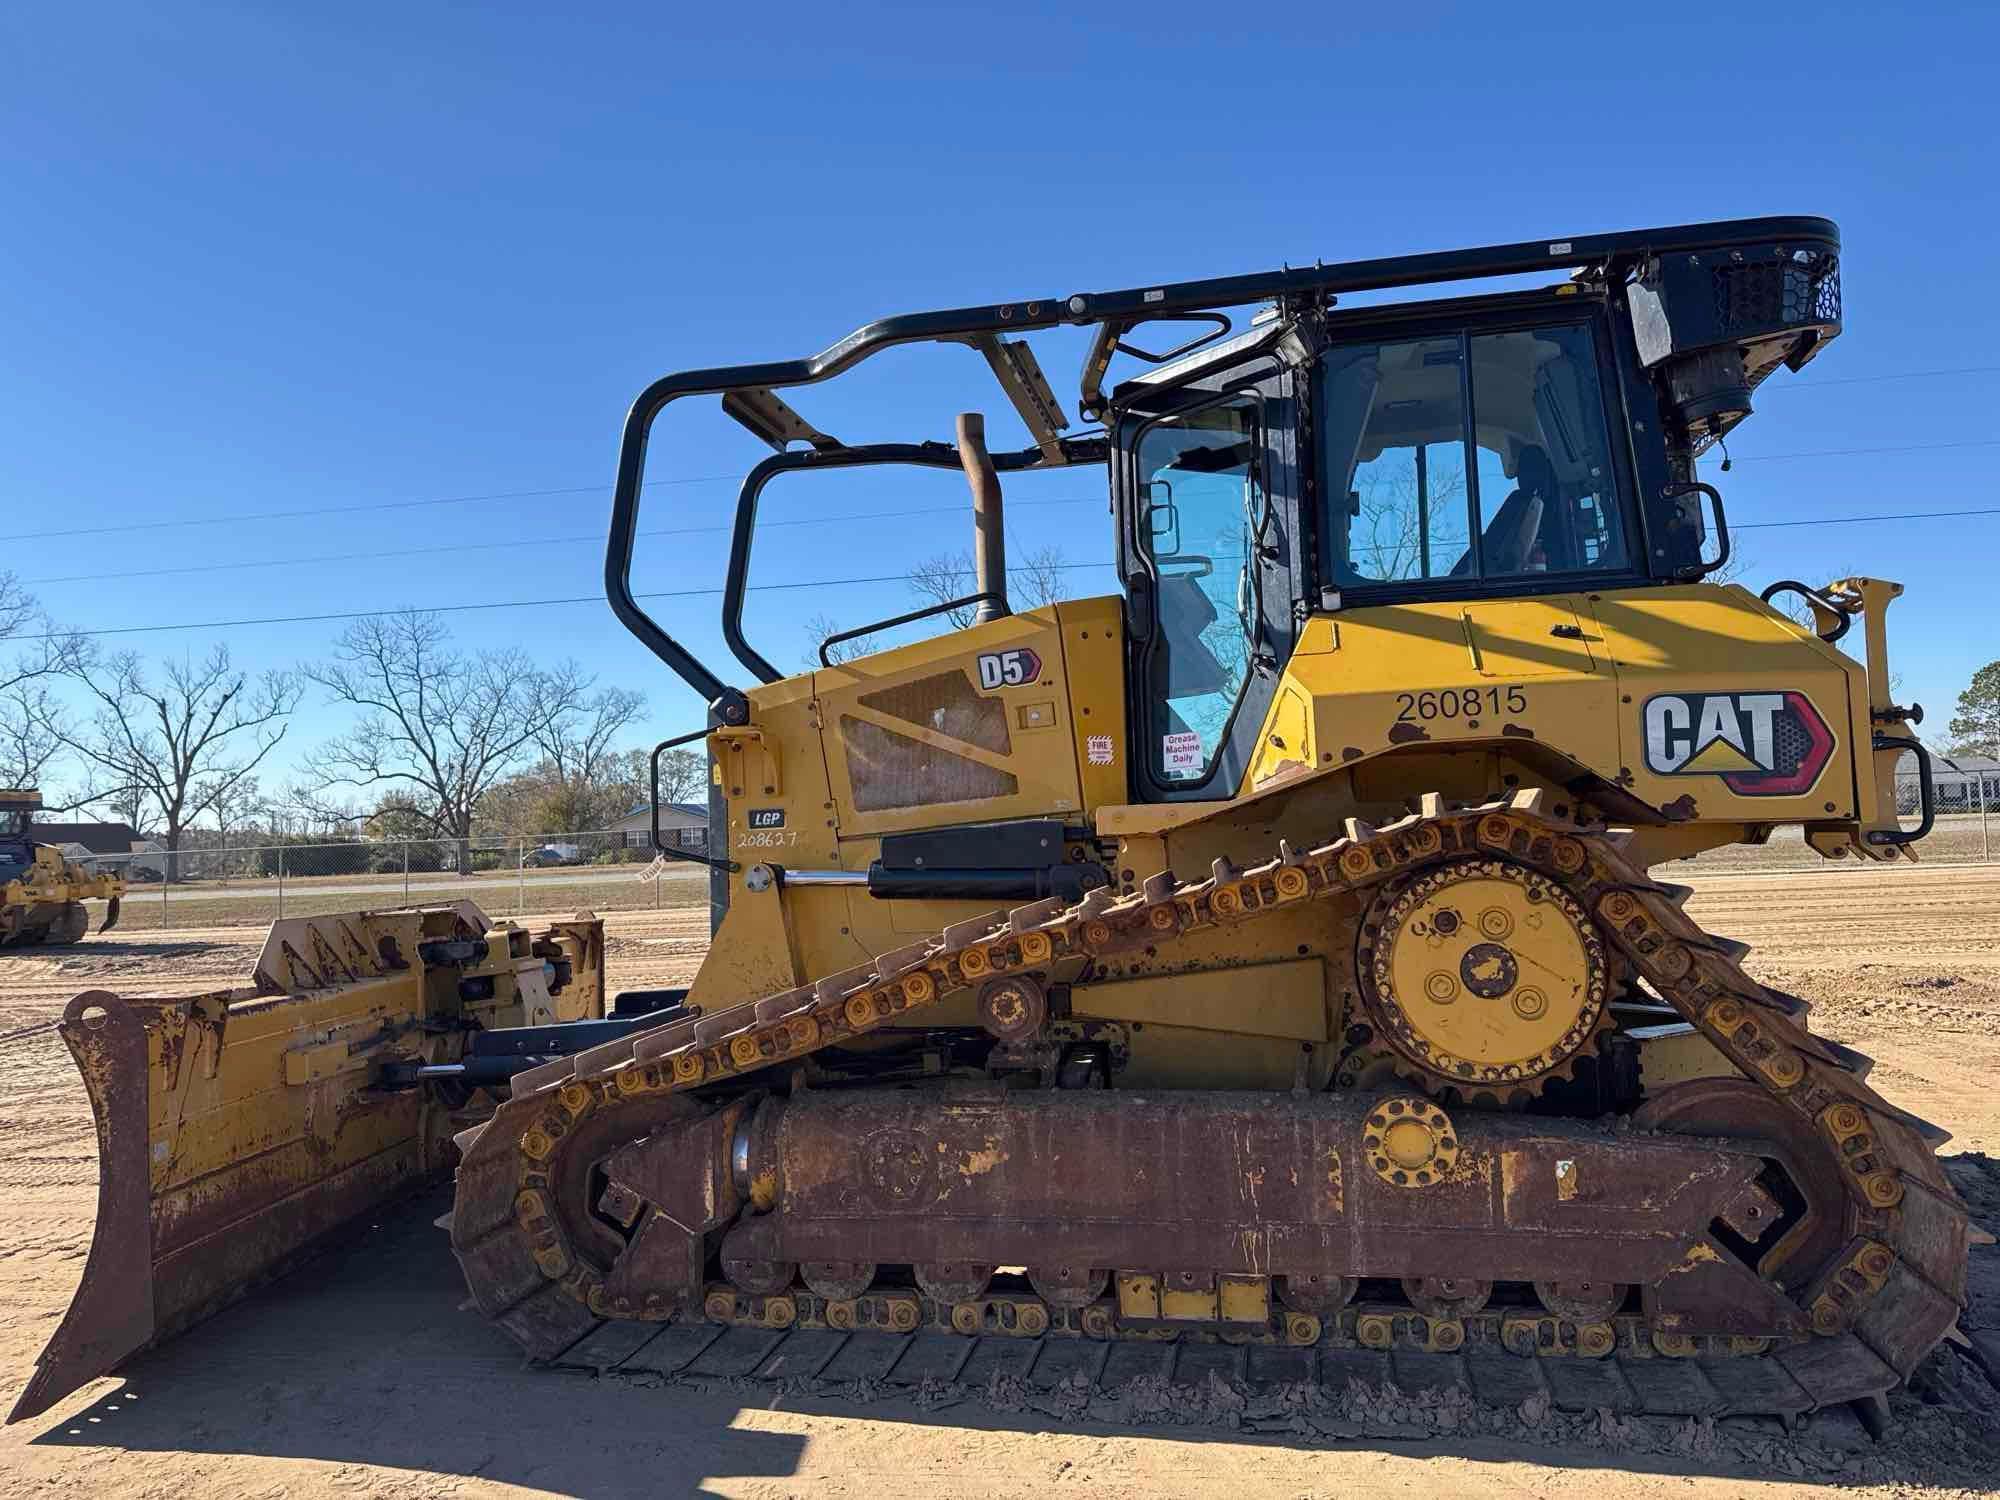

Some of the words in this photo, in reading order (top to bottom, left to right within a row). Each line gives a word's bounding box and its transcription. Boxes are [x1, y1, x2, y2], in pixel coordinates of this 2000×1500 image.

[980, 651, 1023, 688] D5
[1396, 685, 1527, 721] 260815
[1168, 734, 1197, 744] Grease
[1646, 694, 1784, 772] CAT
[1092, 741, 1108, 750] FIRE
[1166, 744, 1200, 754] Machine
[1173, 753, 1193, 763] Daily
[755, 812, 780, 825] LGP
[737, 831, 797, 848] 208627
